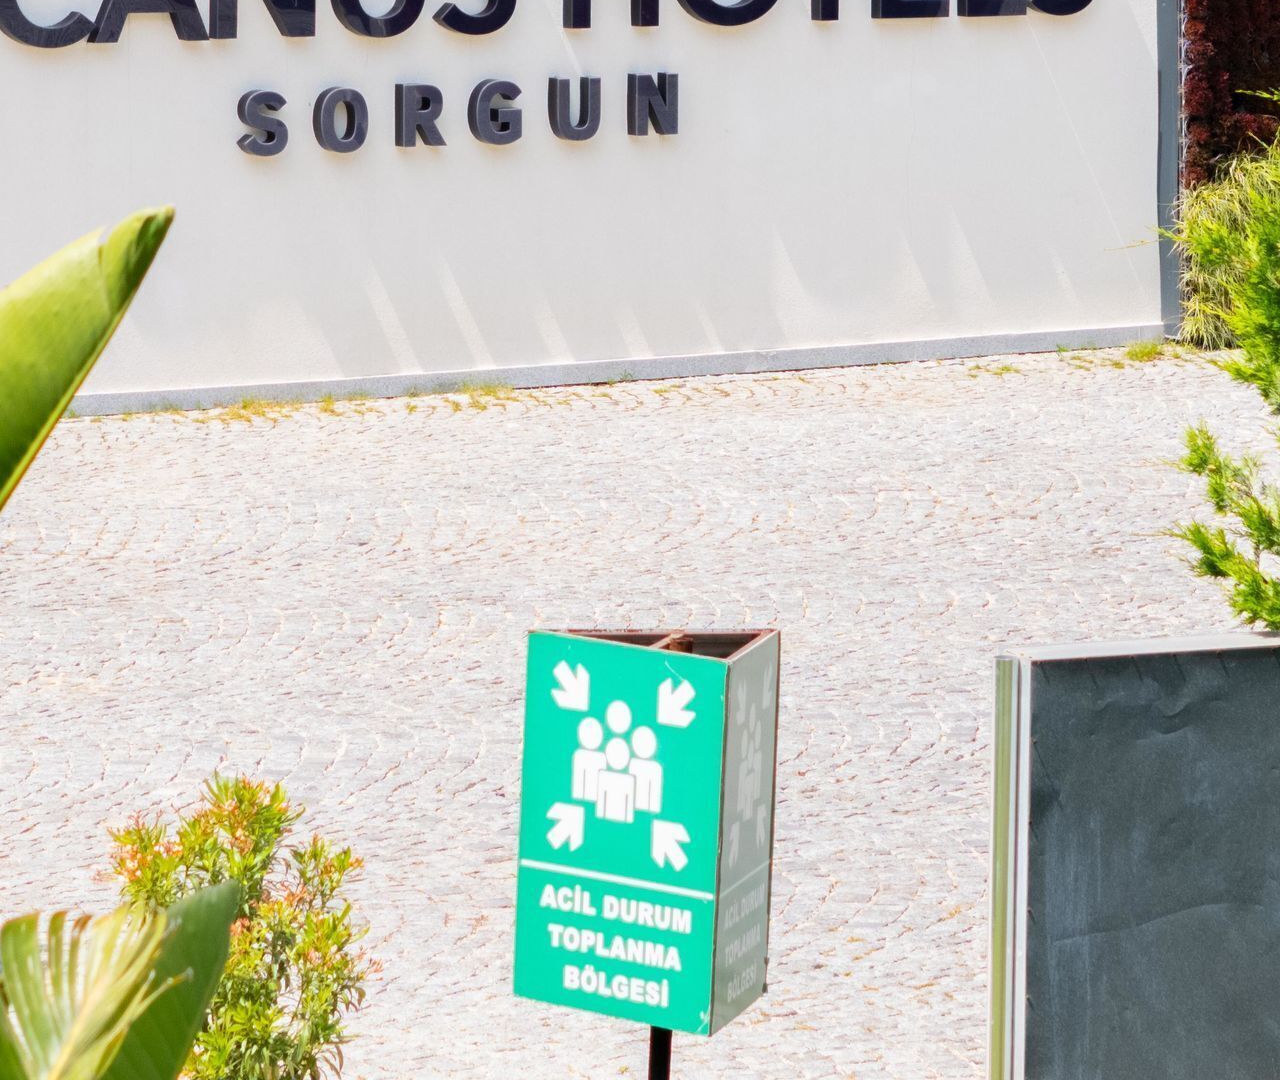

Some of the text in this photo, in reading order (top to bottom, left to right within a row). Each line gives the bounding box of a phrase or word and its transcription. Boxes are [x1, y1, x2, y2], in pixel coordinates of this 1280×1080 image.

[237, 71, 680, 157] SORGUN
[539, 883, 692, 934] ACİL DURUM
[547, 922, 682, 972] TOPLANMA
[563, 964, 669, 1008] BÖLGESİ
